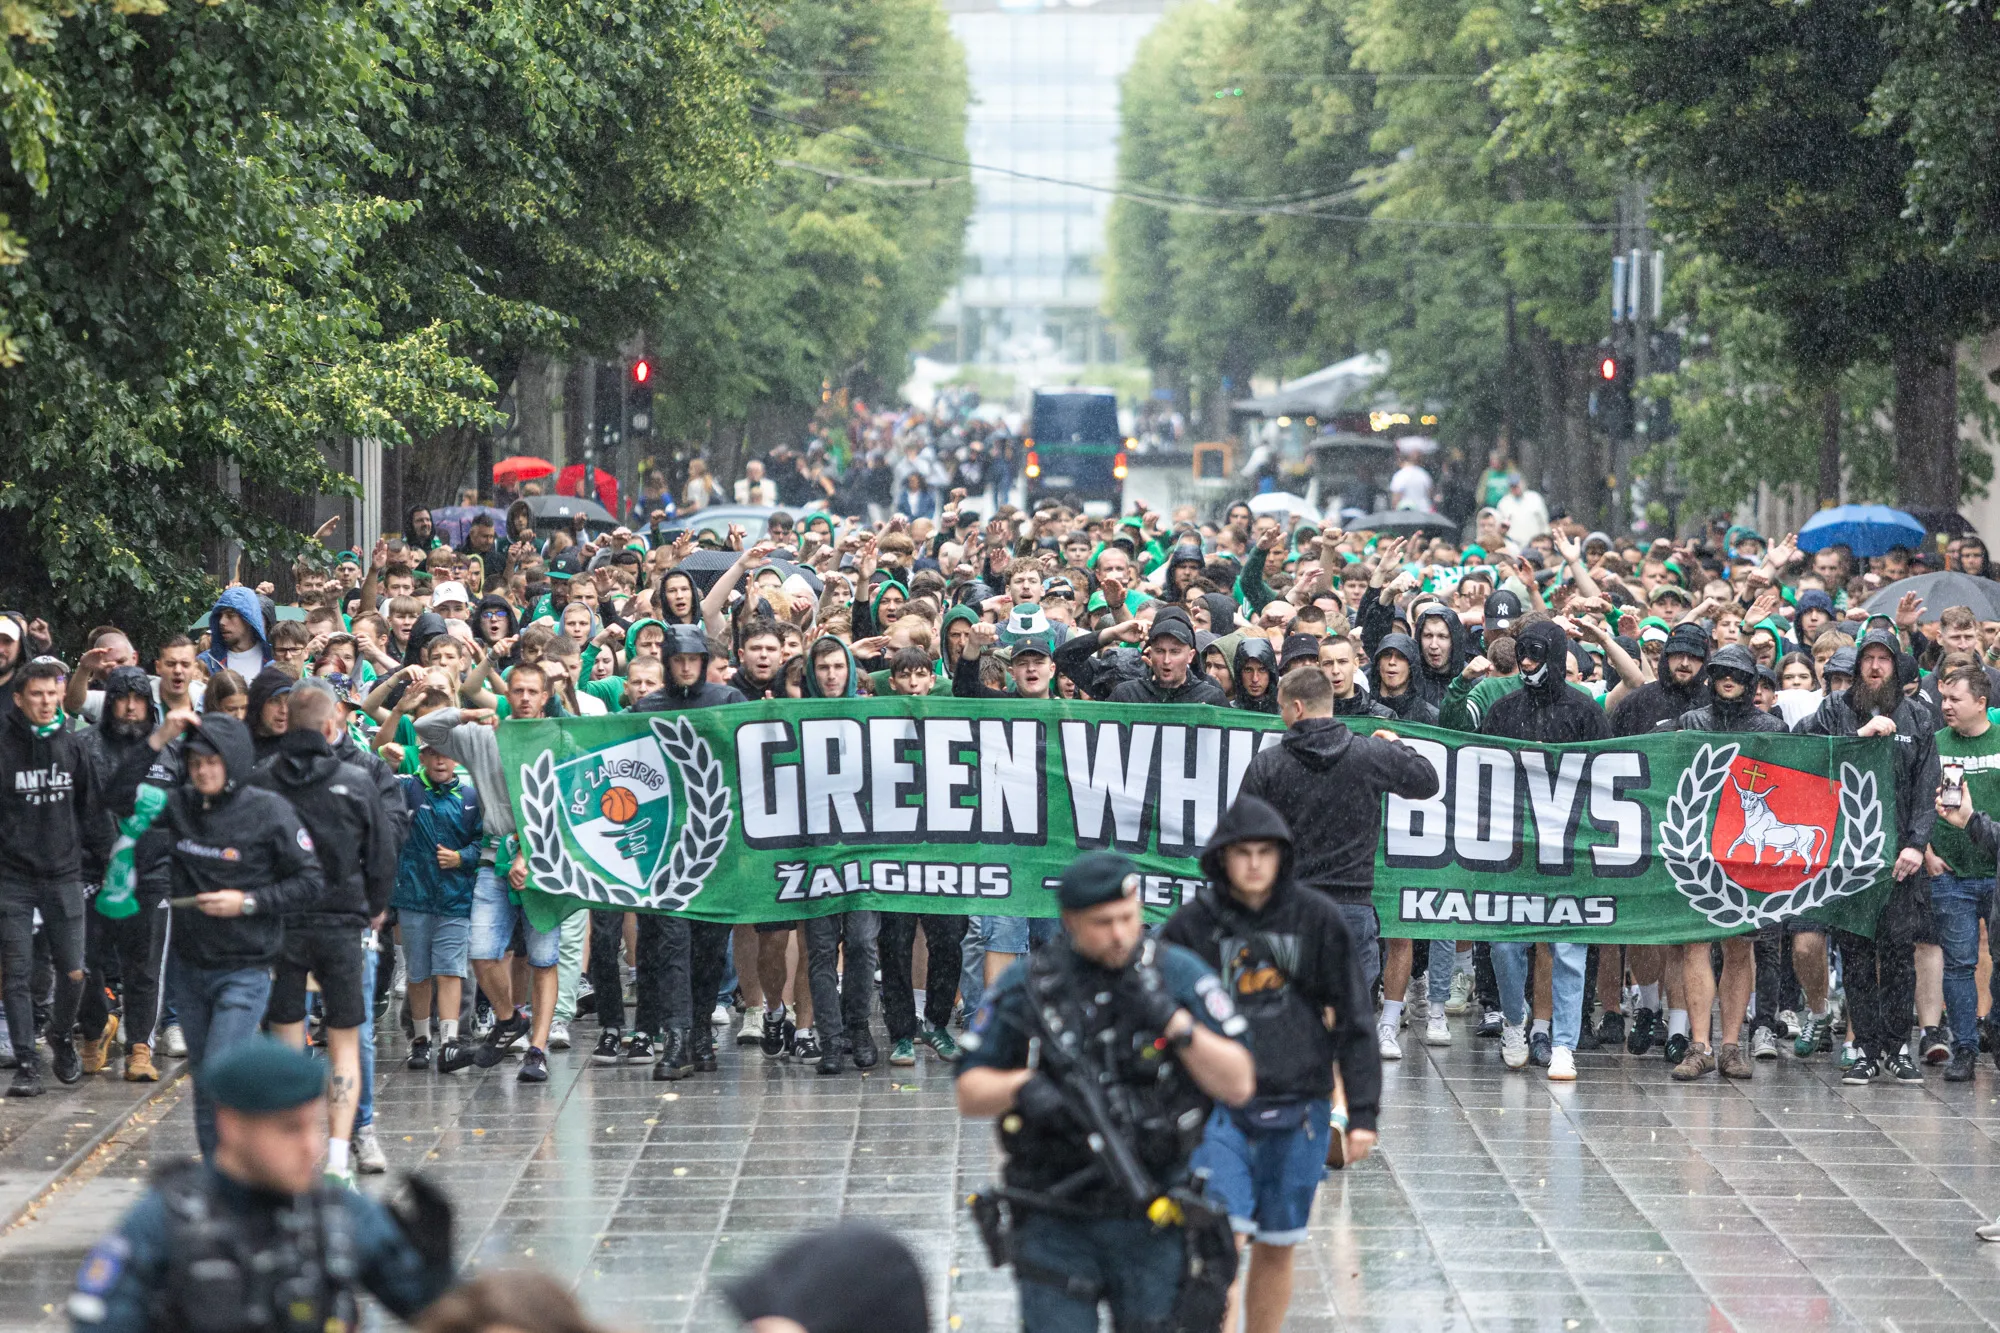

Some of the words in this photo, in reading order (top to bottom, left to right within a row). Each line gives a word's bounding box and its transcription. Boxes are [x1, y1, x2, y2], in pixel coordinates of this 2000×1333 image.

[570, 788, 590, 816] BC
[584, 759, 665, 791] ŽALGIRIS
[738, 717, 1043, 842] GREEN
[1061, 721, 1285, 850] WHI
[1386, 737, 1647, 870] BOYS
[777, 862, 1010, 901] ŽALGIRIS
[1403, 889, 1615, 925] KAUNAS
